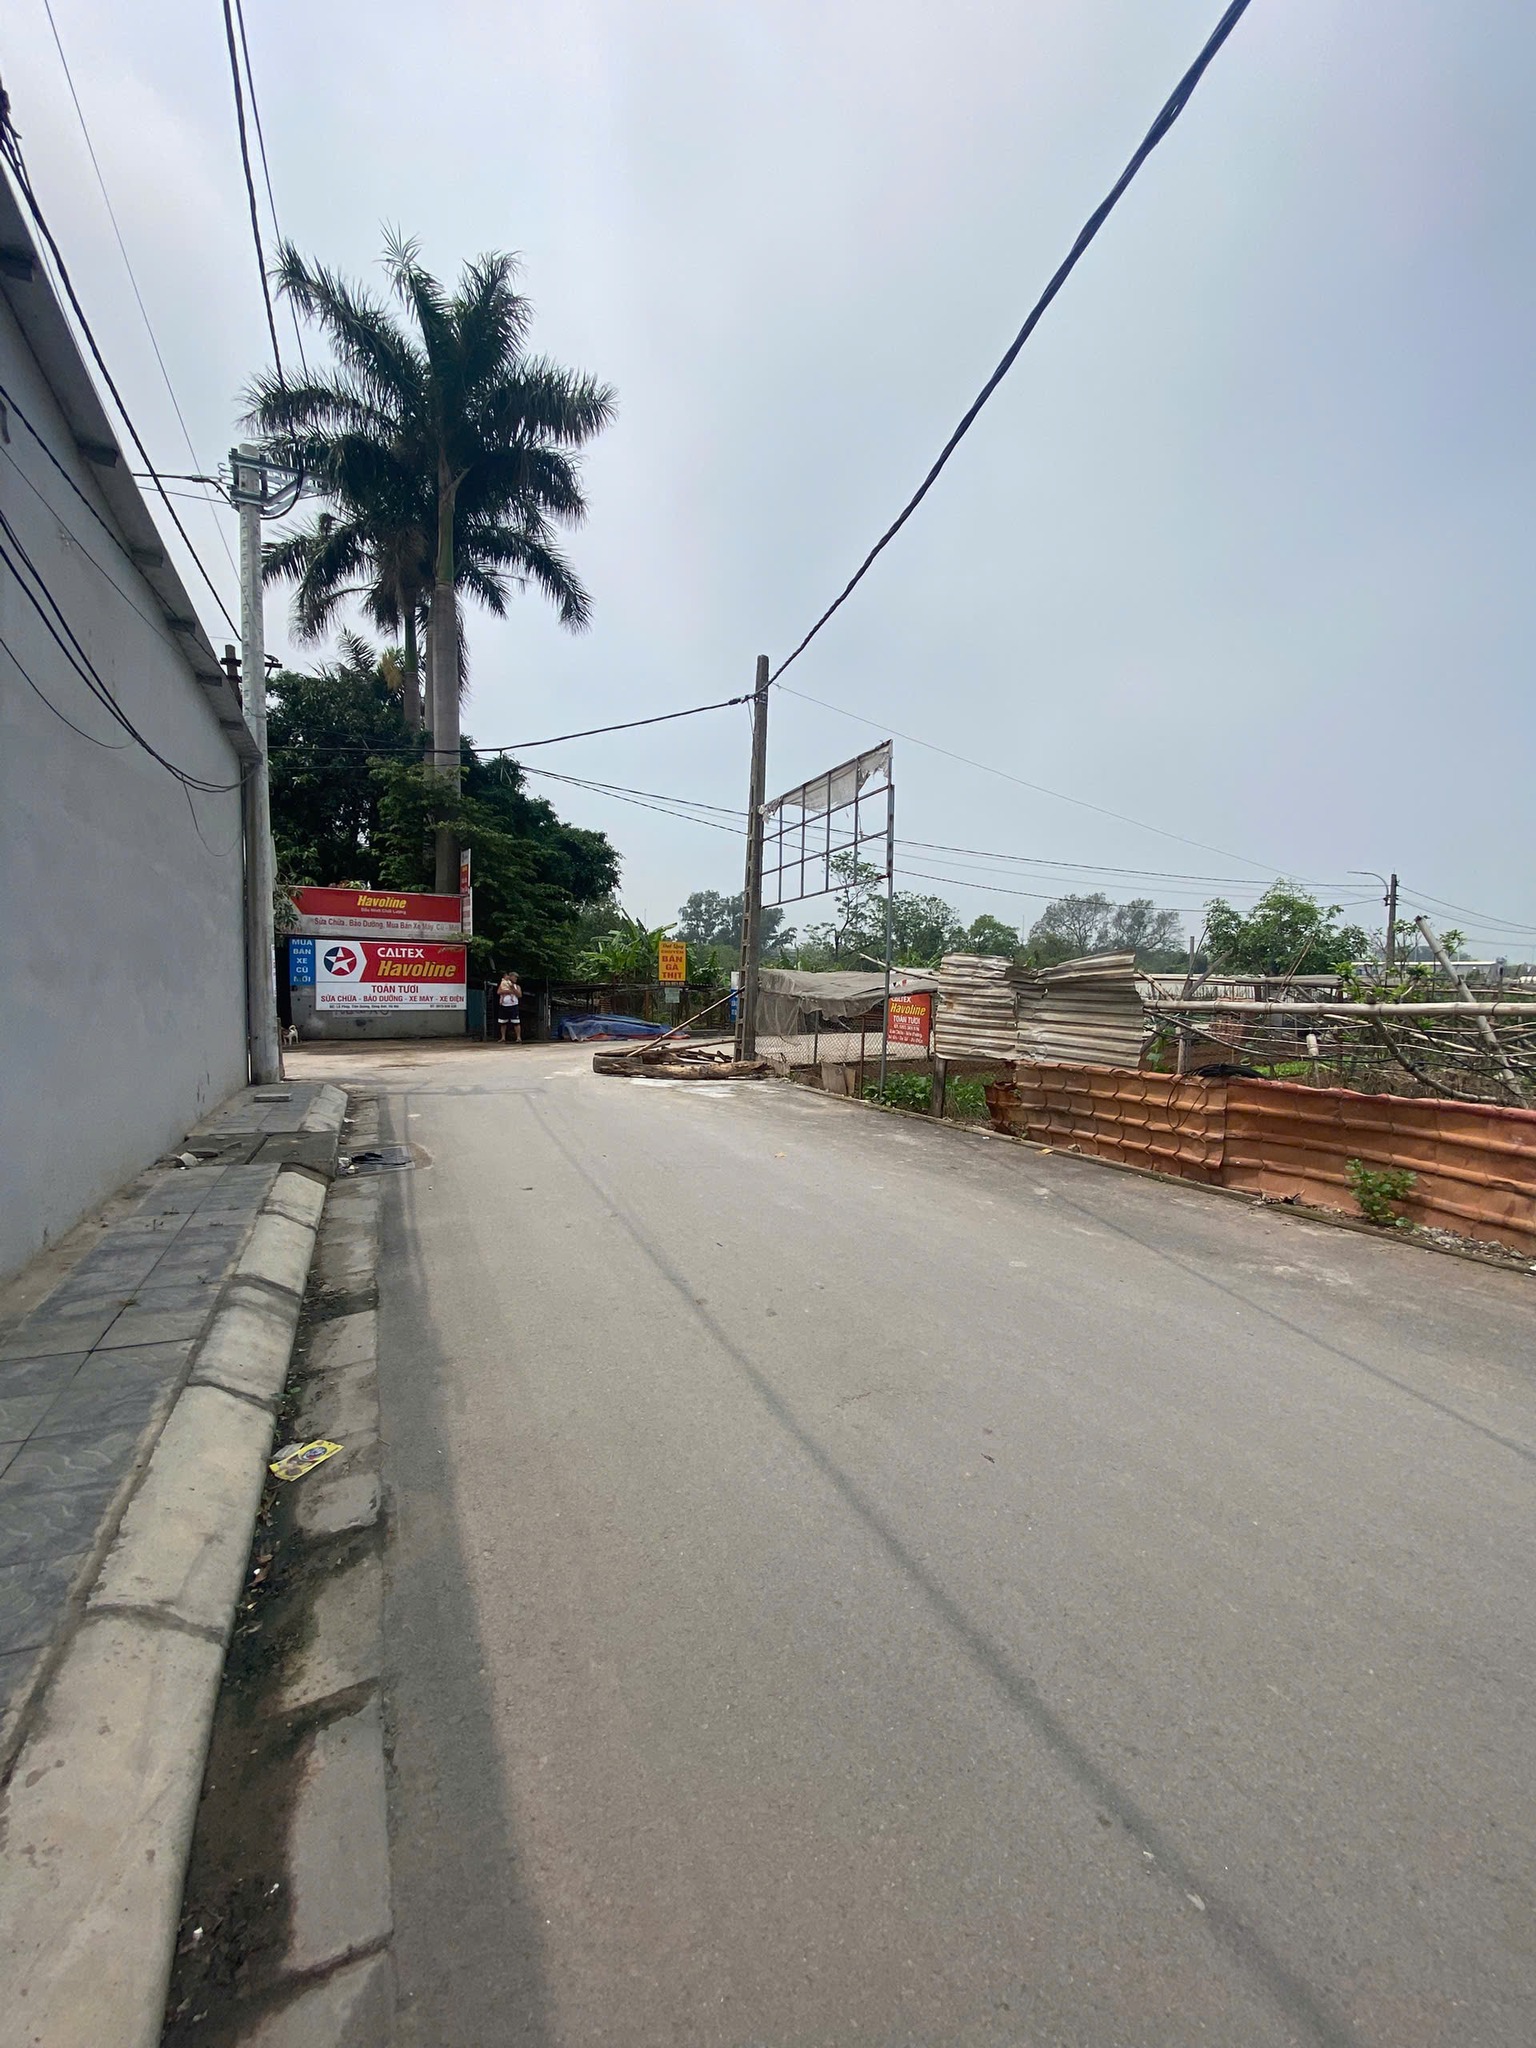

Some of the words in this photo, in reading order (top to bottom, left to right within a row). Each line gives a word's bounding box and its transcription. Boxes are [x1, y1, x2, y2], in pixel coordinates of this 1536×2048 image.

[357, 895, 406, 909] Havoline
[386, 921, 399, 929] Mua
[377, 947, 424, 958] CALTEX
[377, 960, 456, 977] Havoline
[890, 1003, 926, 1016] Havoline
